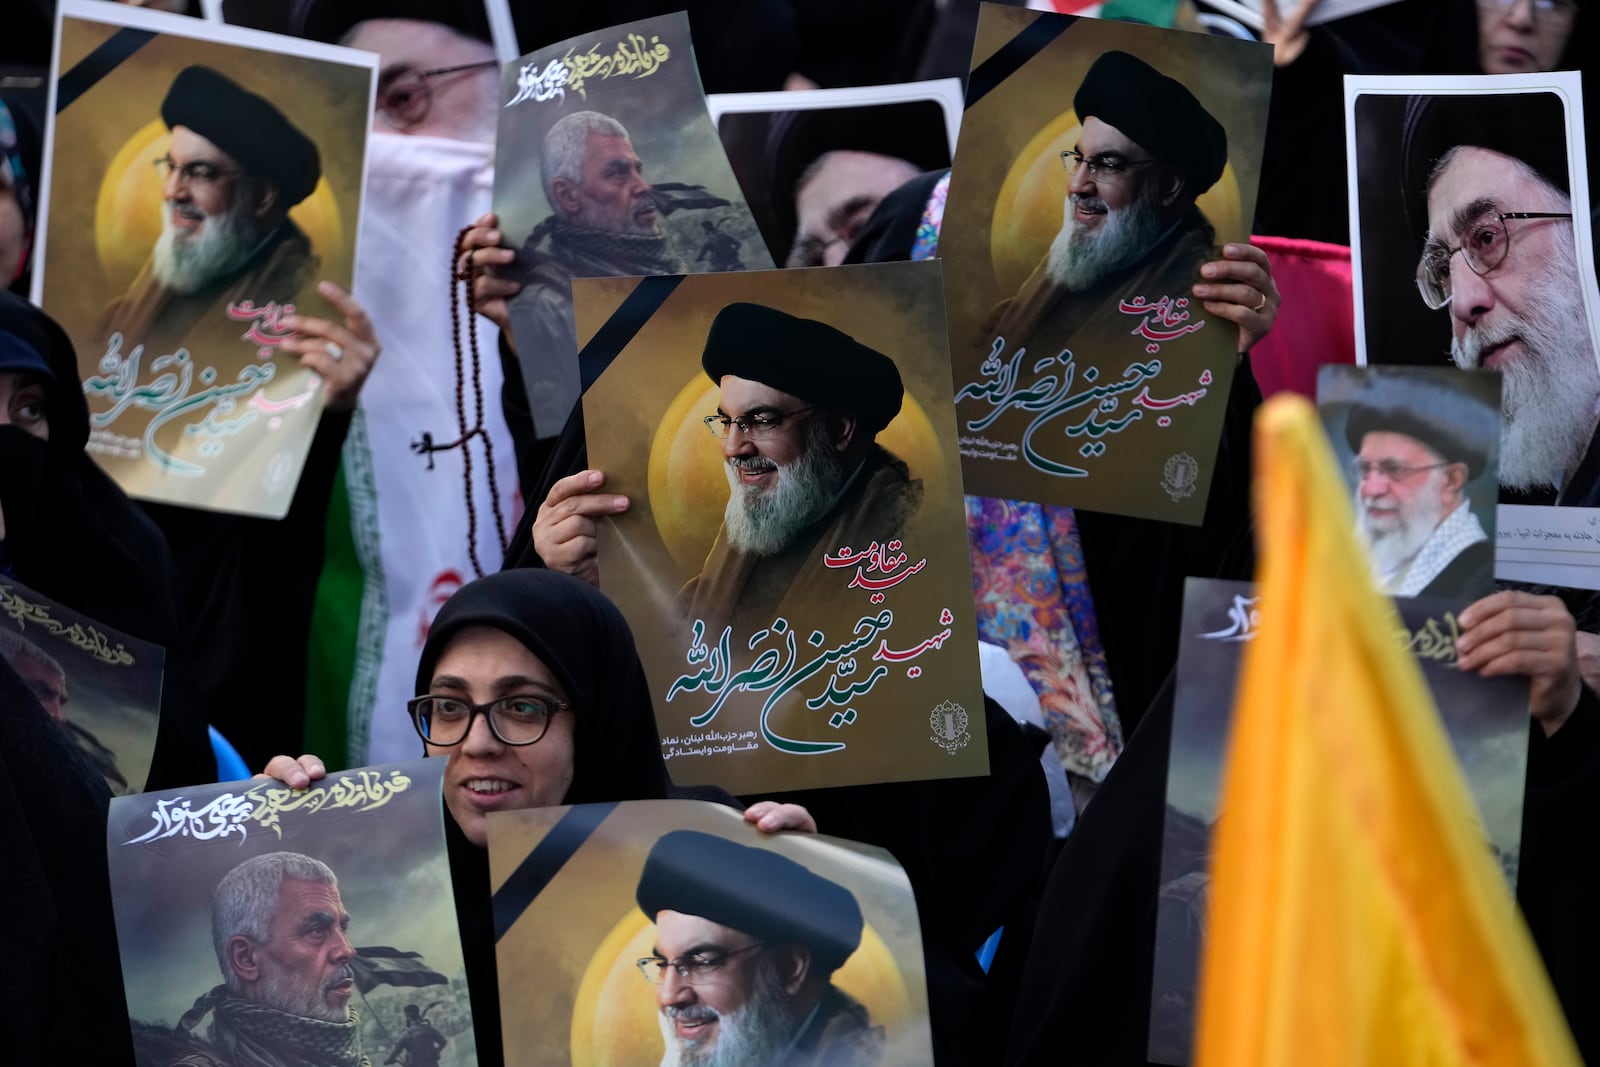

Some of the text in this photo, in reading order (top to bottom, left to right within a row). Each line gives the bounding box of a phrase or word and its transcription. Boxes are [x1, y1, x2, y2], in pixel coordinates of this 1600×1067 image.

[1119, 294, 1205, 353] سید مقاومت
[144, 362, 276, 478] حسین
[1022, 359, 1162, 478] حسین
[1132, 369, 1213, 427] شهید
[824, 539, 927, 604] سید مقاومت
[872, 608, 954, 679] شهید
[760, 609, 893, 755] حسین
[661, 736, 680, 745] نماد
[738, 730, 757, 740] رهبر
[320, 770, 412, 813] فرمانده
